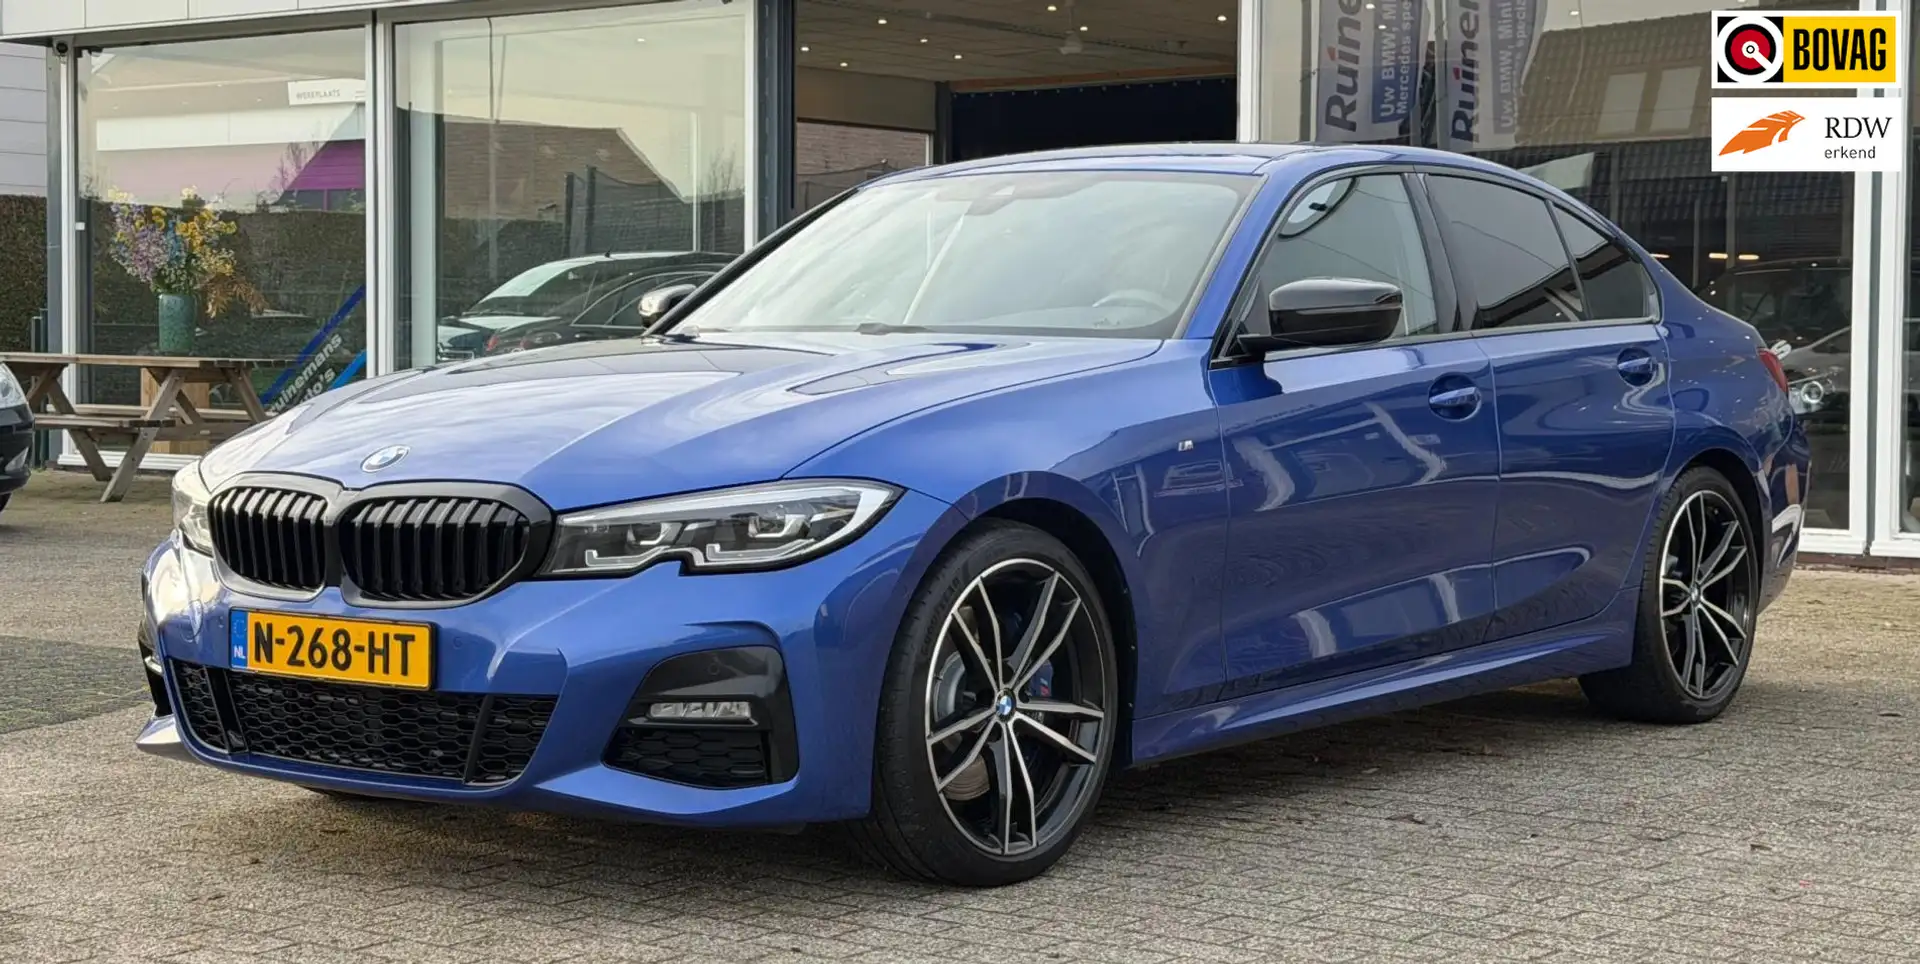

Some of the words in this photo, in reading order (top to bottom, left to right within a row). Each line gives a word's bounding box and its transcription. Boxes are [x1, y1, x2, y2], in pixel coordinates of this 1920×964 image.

[1497, 1, 1513, 39] Mini
[1381, 26, 1399, 80] BMW,
[1396, 35, 1412, 115] Mercedes
[1381, 86, 1396, 117] Uw
[1500, 99, 1514, 128] Uw
[233, 645, 246, 660] NL
[254, 621, 416, 677] N-268-HT
